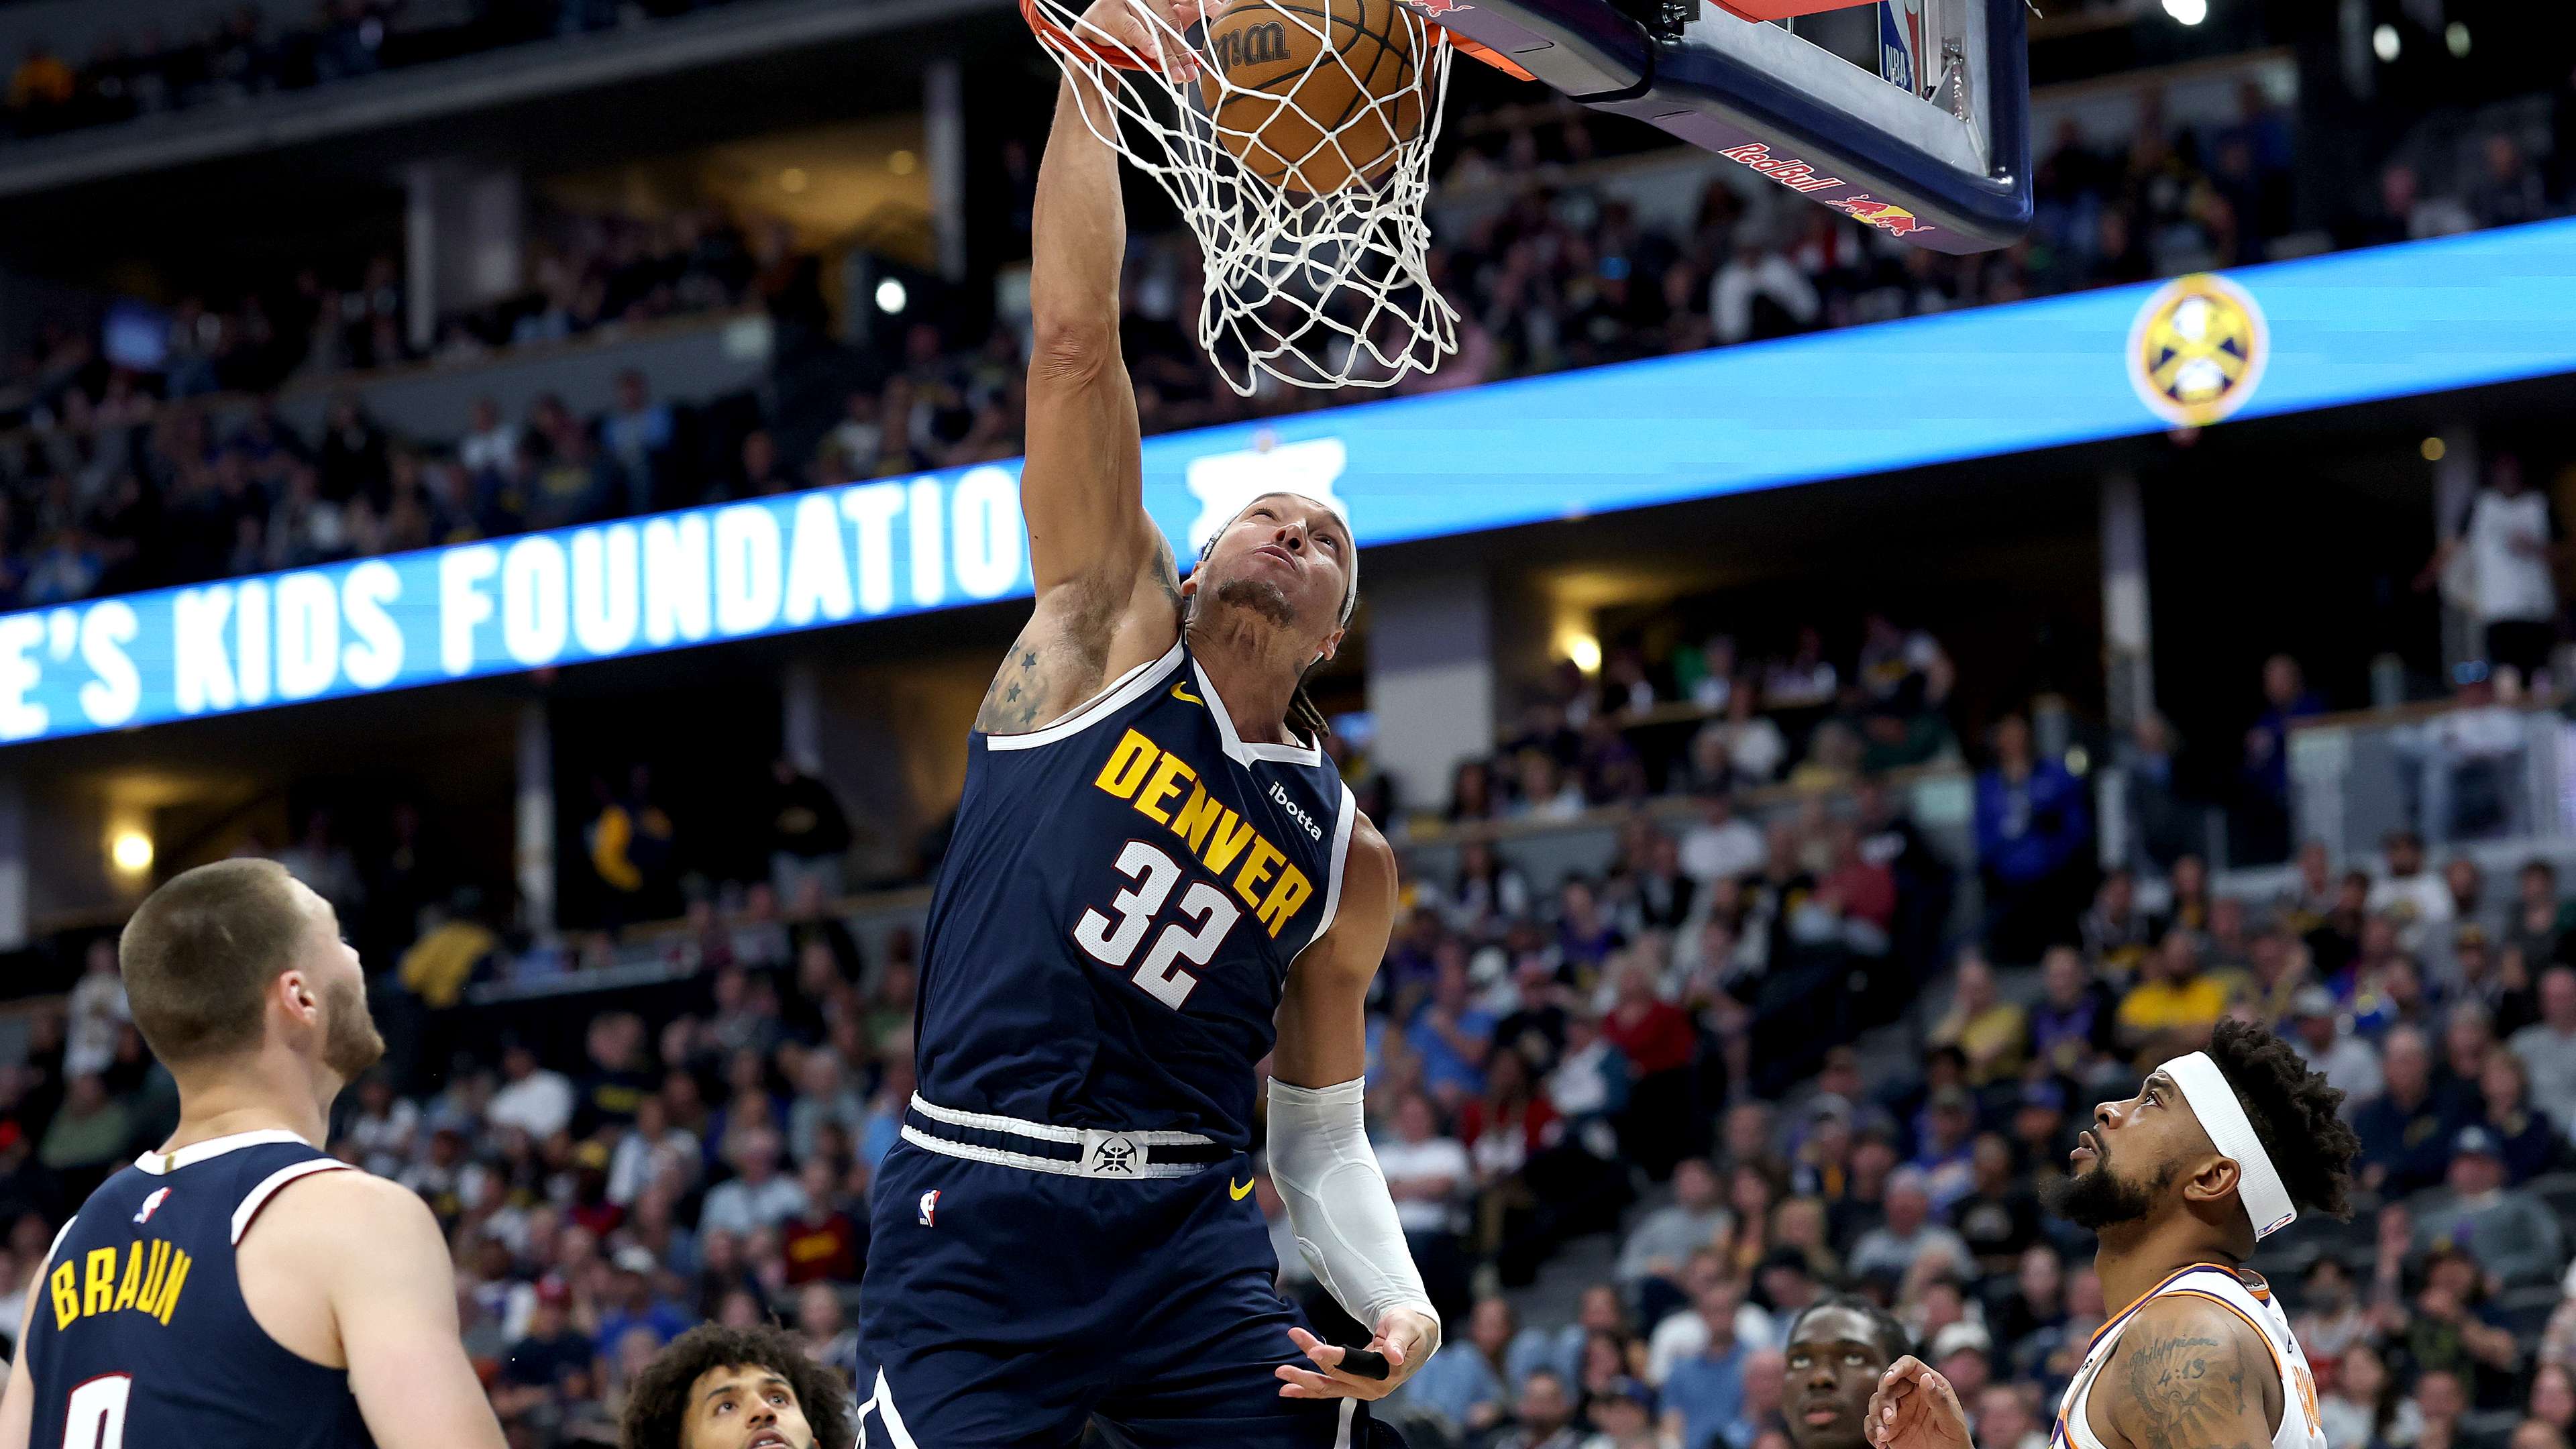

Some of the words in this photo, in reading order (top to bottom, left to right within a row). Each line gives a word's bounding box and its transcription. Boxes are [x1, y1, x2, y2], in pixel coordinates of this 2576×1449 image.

[1885, 44, 1907, 87] NBA
[173, 559, 404, 715] KIDS
[438, 466, 1035, 676] FOUNDATIO
[1094, 728, 1314, 939] DENVER
[1269, 781, 1322, 841] ibotta
[1071, 839, 1244, 1012] 32
[50, 1238, 193, 1332] BRAUN
